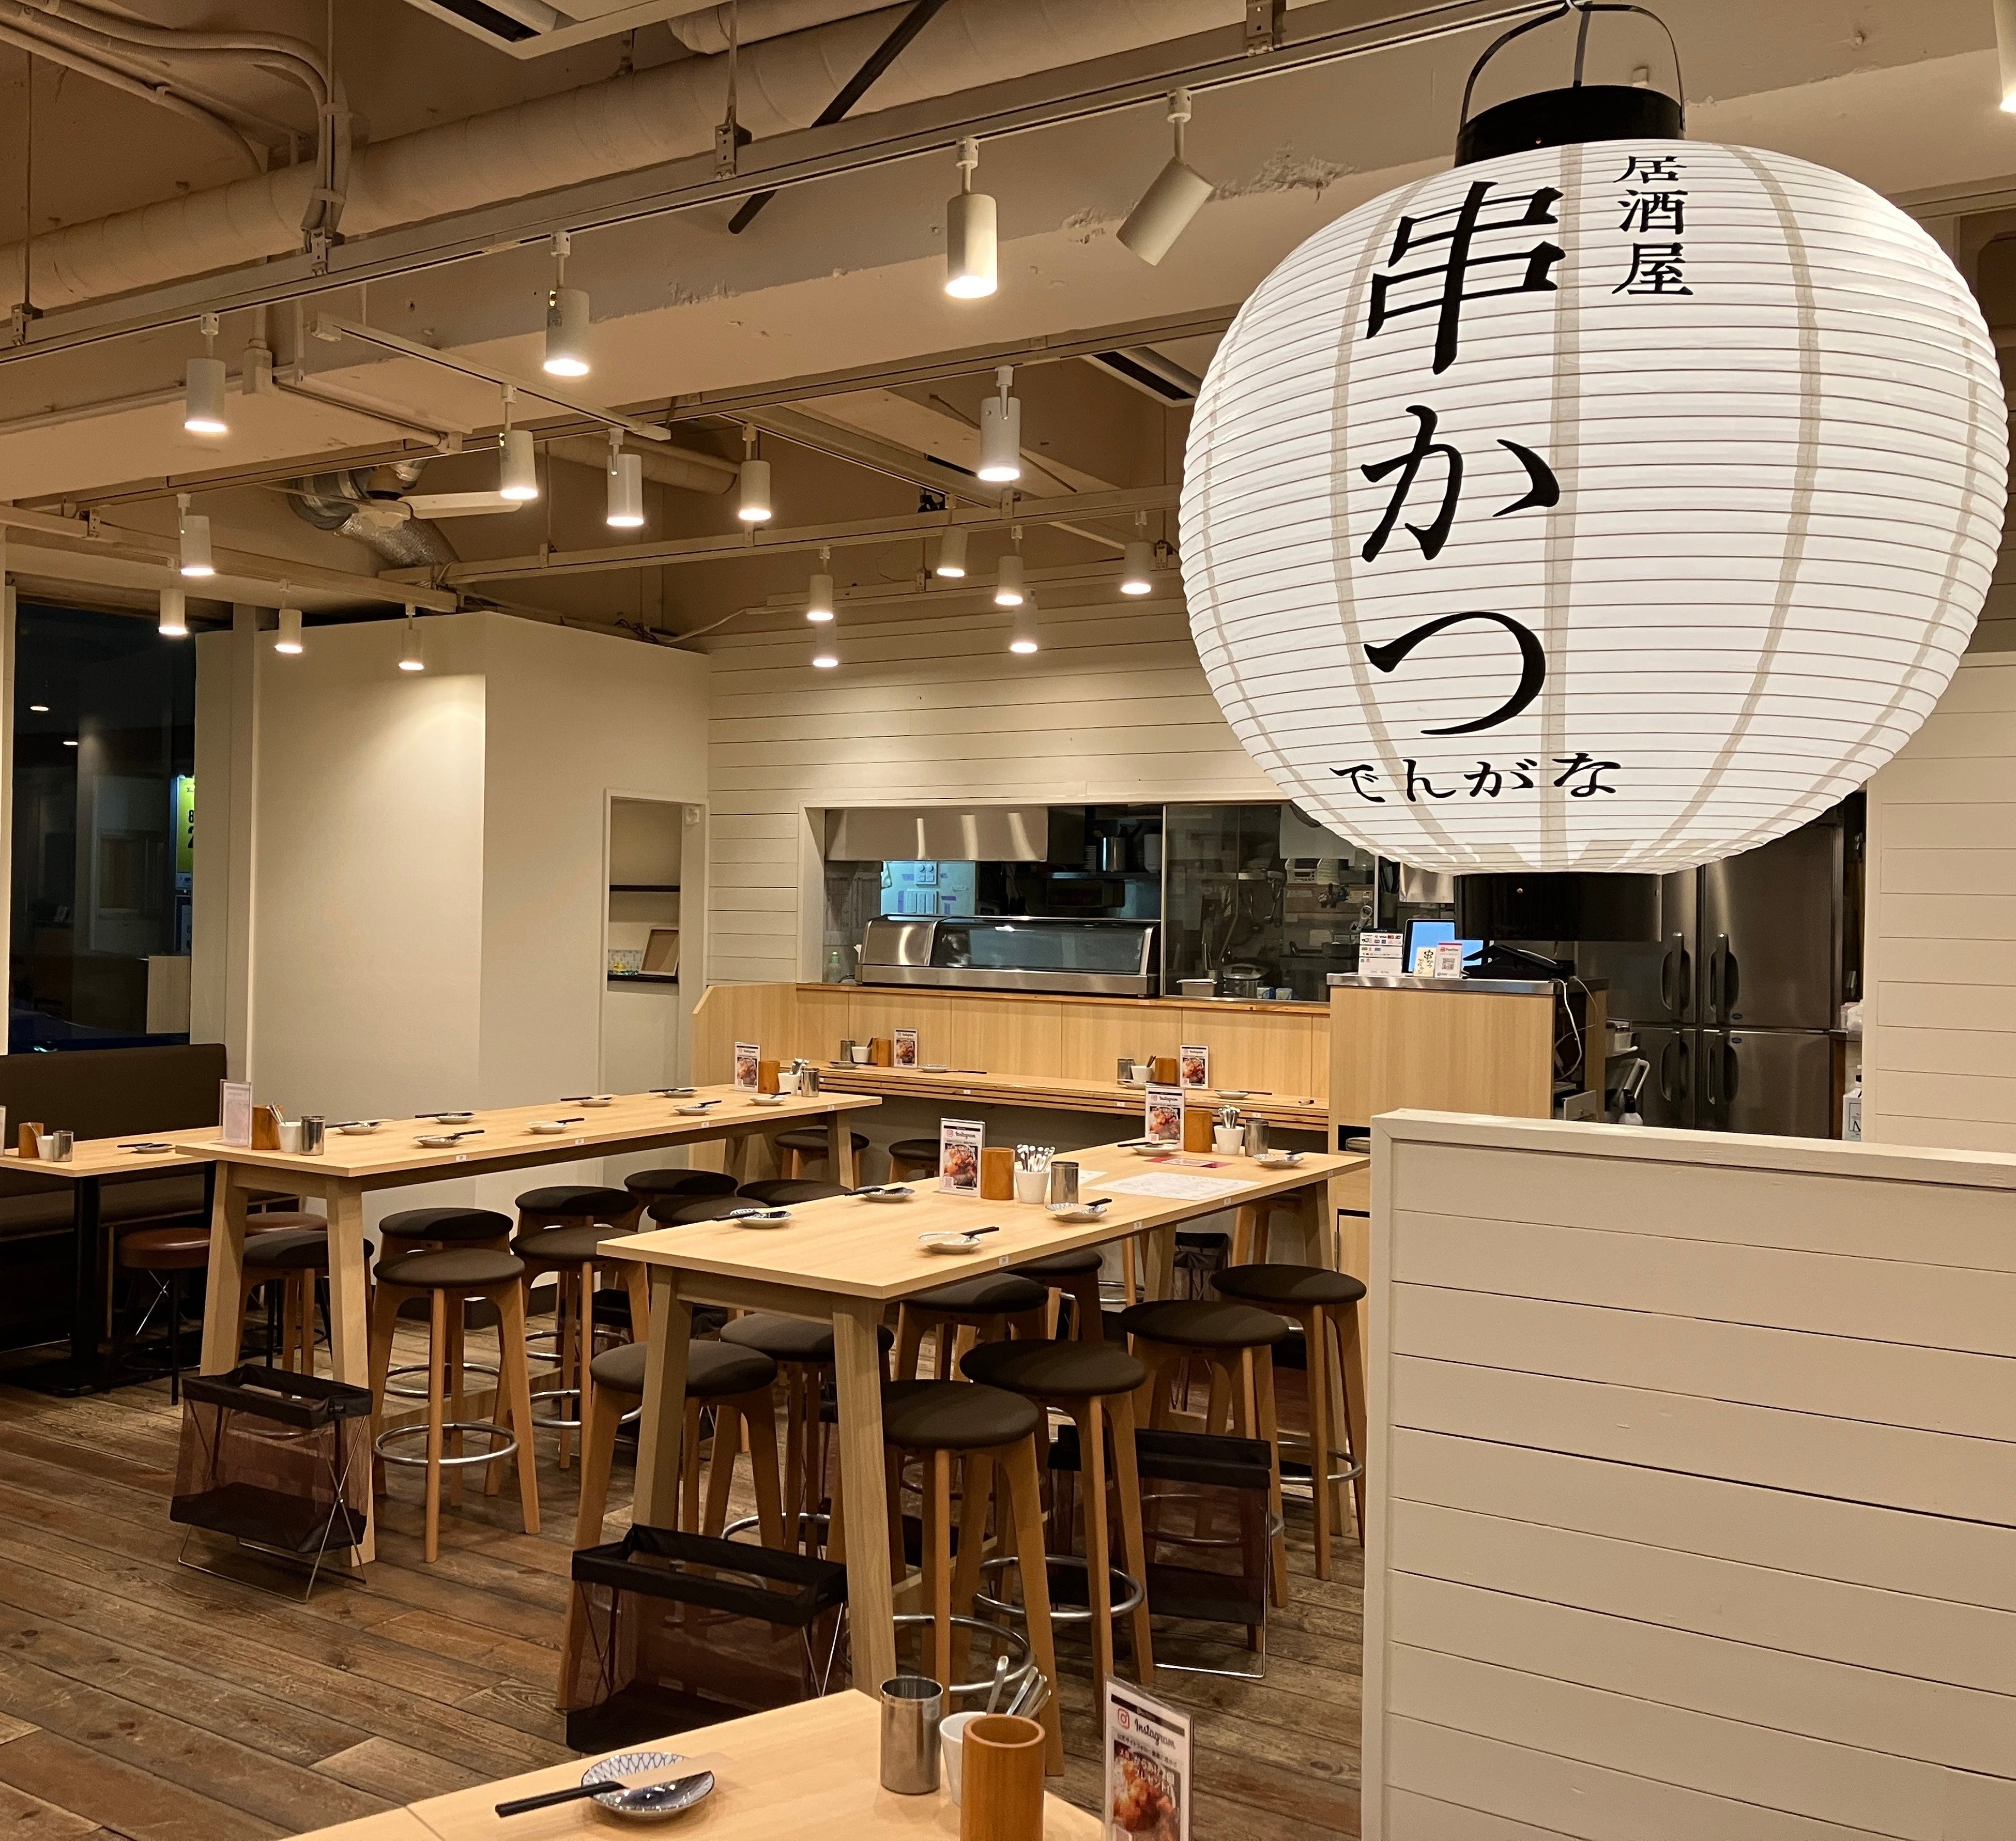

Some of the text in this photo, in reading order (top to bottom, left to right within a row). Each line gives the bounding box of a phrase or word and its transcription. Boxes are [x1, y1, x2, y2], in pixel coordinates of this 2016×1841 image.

[1612, 156, 1692, 295] 居酒屋
[1361, 181, 1565, 735] 串かつ
[1330, 753, 1621, 802] でんがな
[1134, 1718, 1176, 1749] Instagram
